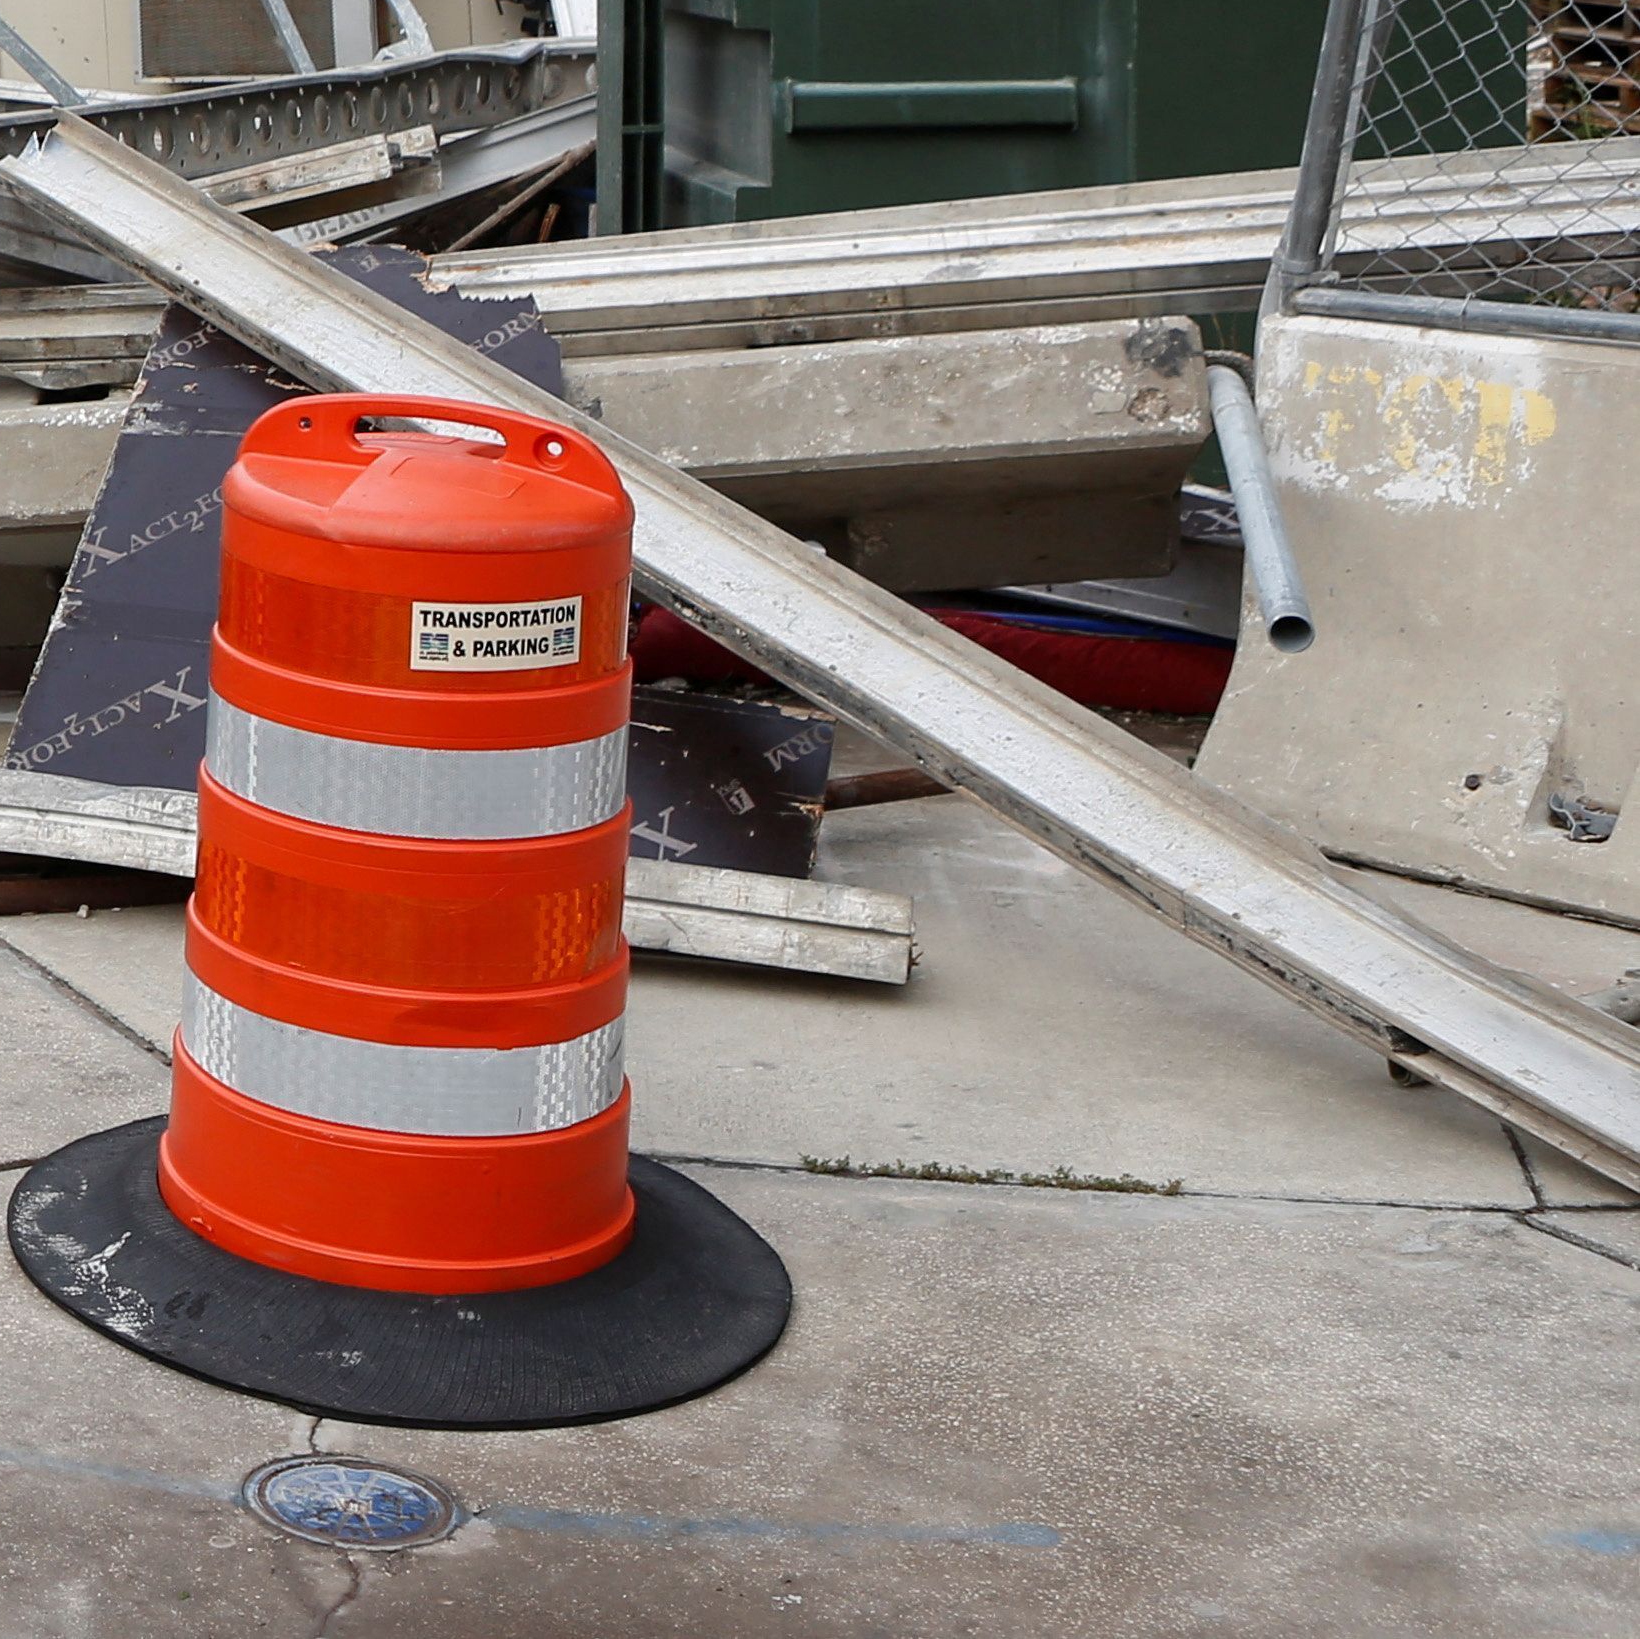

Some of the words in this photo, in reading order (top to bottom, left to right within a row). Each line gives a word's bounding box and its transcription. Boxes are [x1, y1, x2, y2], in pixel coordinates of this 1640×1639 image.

[419, 605, 576, 629] TRANSPORTATION
[453, 640, 466, 658] &
[472, 637, 550, 658] PARKING
